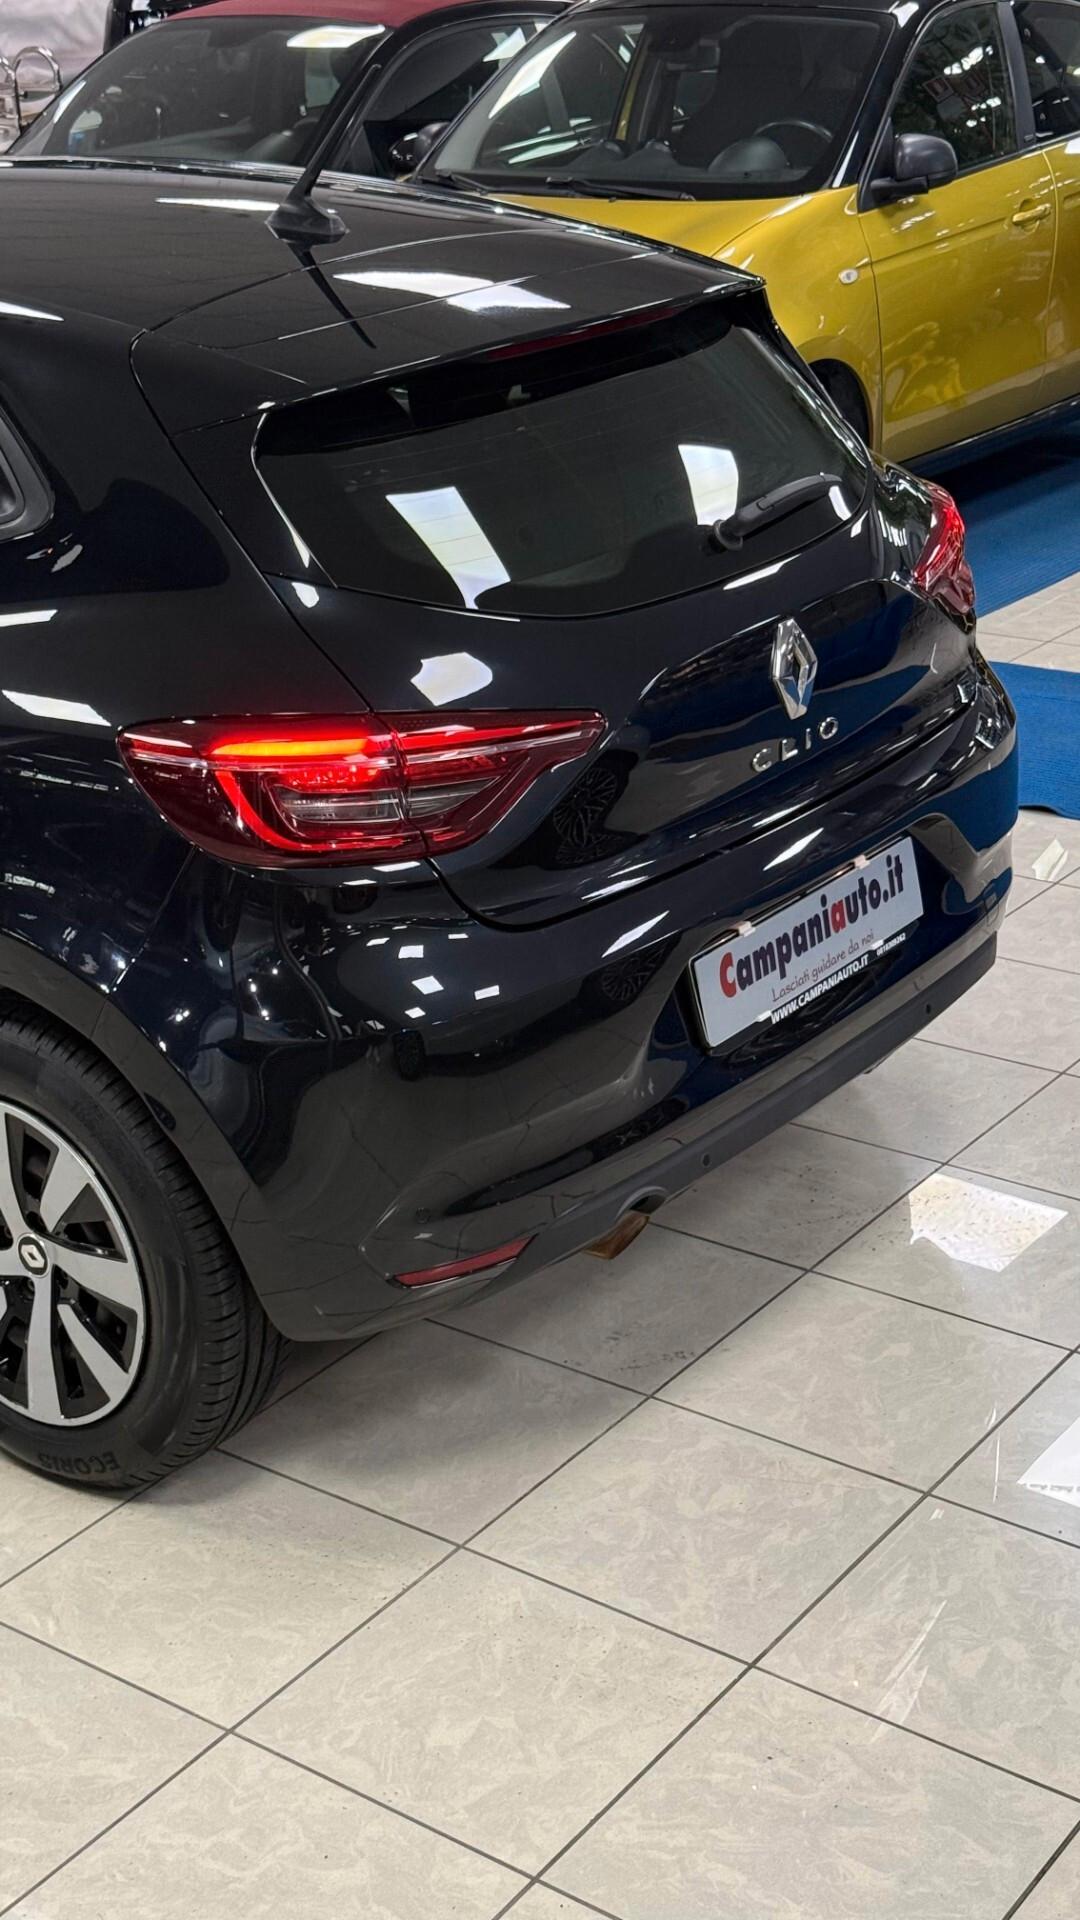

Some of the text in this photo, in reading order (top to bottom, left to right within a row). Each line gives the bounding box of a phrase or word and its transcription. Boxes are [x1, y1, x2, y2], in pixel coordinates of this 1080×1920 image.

[752, 716, 838, 772] CLIO
[719, 854, 904, 998] Campaniauto.it
[770, 953, 870, 1024] WWW.CAMPANIAUTO.IT
[771, 965, 811, 1002] Lasciati
[812, 952, 846, 981] guidare
[848, 940, 860, 954] da
[861, 928, 875, 945] noi
